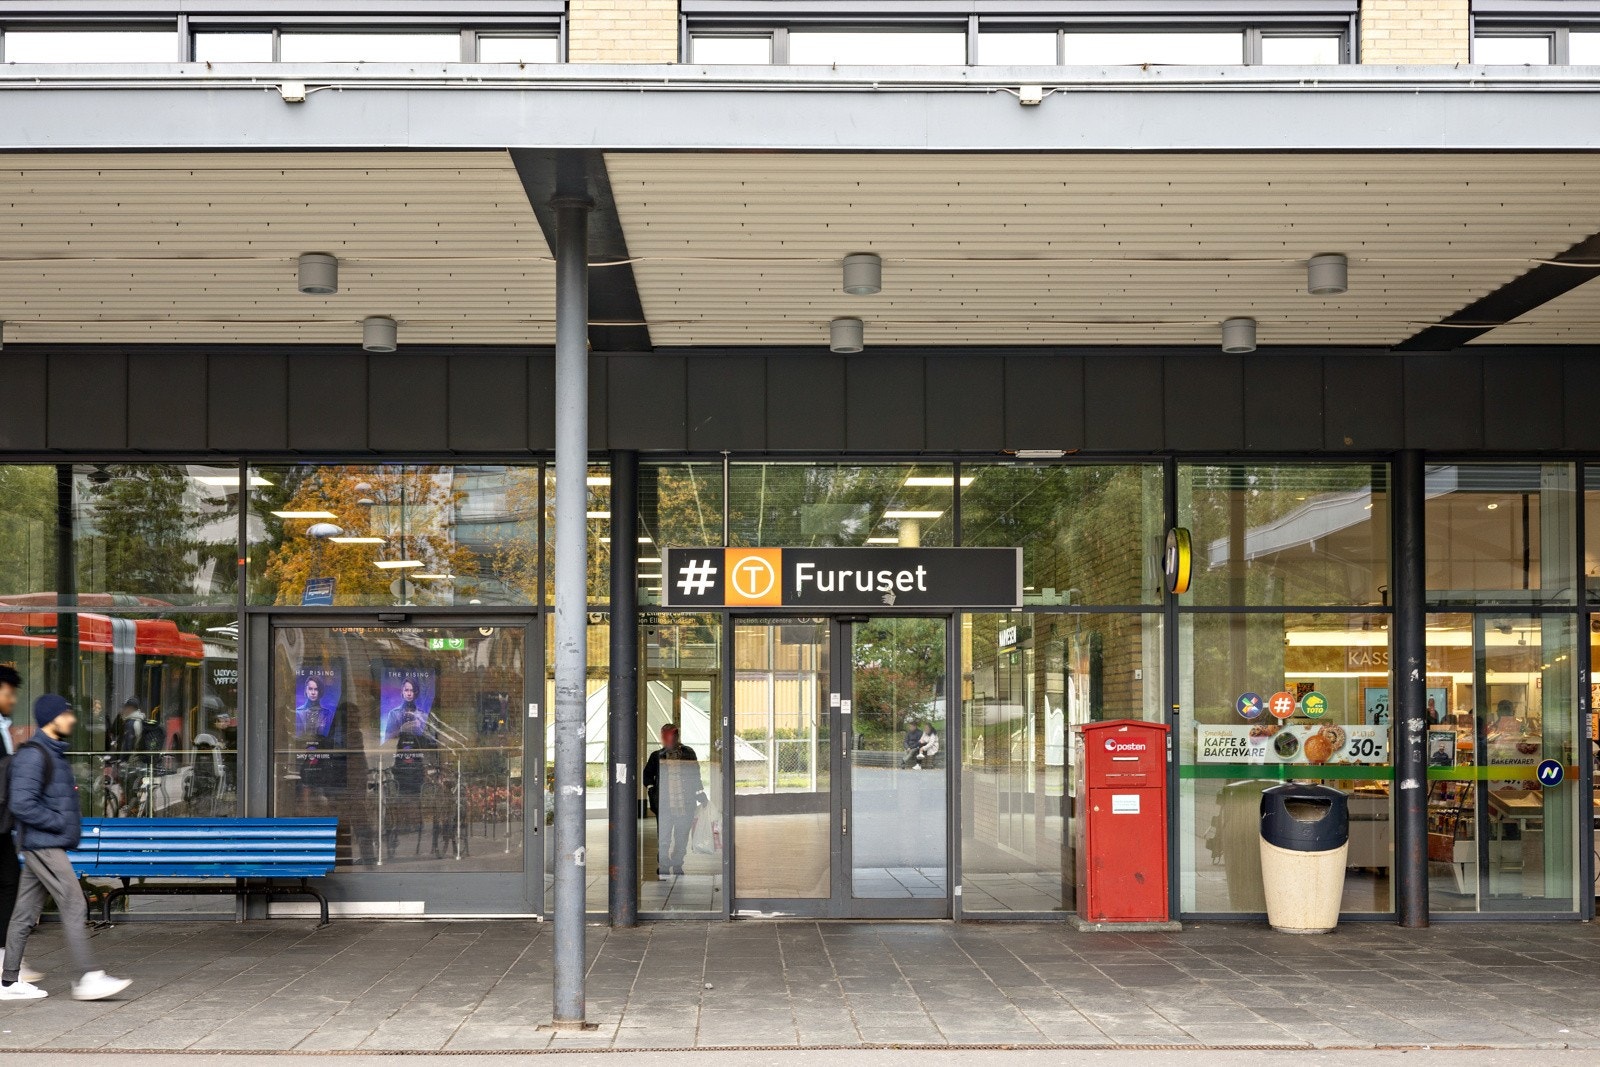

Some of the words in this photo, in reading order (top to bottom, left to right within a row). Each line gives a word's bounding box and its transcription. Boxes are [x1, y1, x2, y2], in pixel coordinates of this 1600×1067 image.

[795, 562, 927, 592] Furuset
[1348, 651, 1388, 665] KASS
[1204, 737, 1237, 746] KAFFE
[1240, 737, 1247, 746] &
[1116, 742, 1146, 752] posten
[1203, 747, 1266, 757] BAKERVARE
